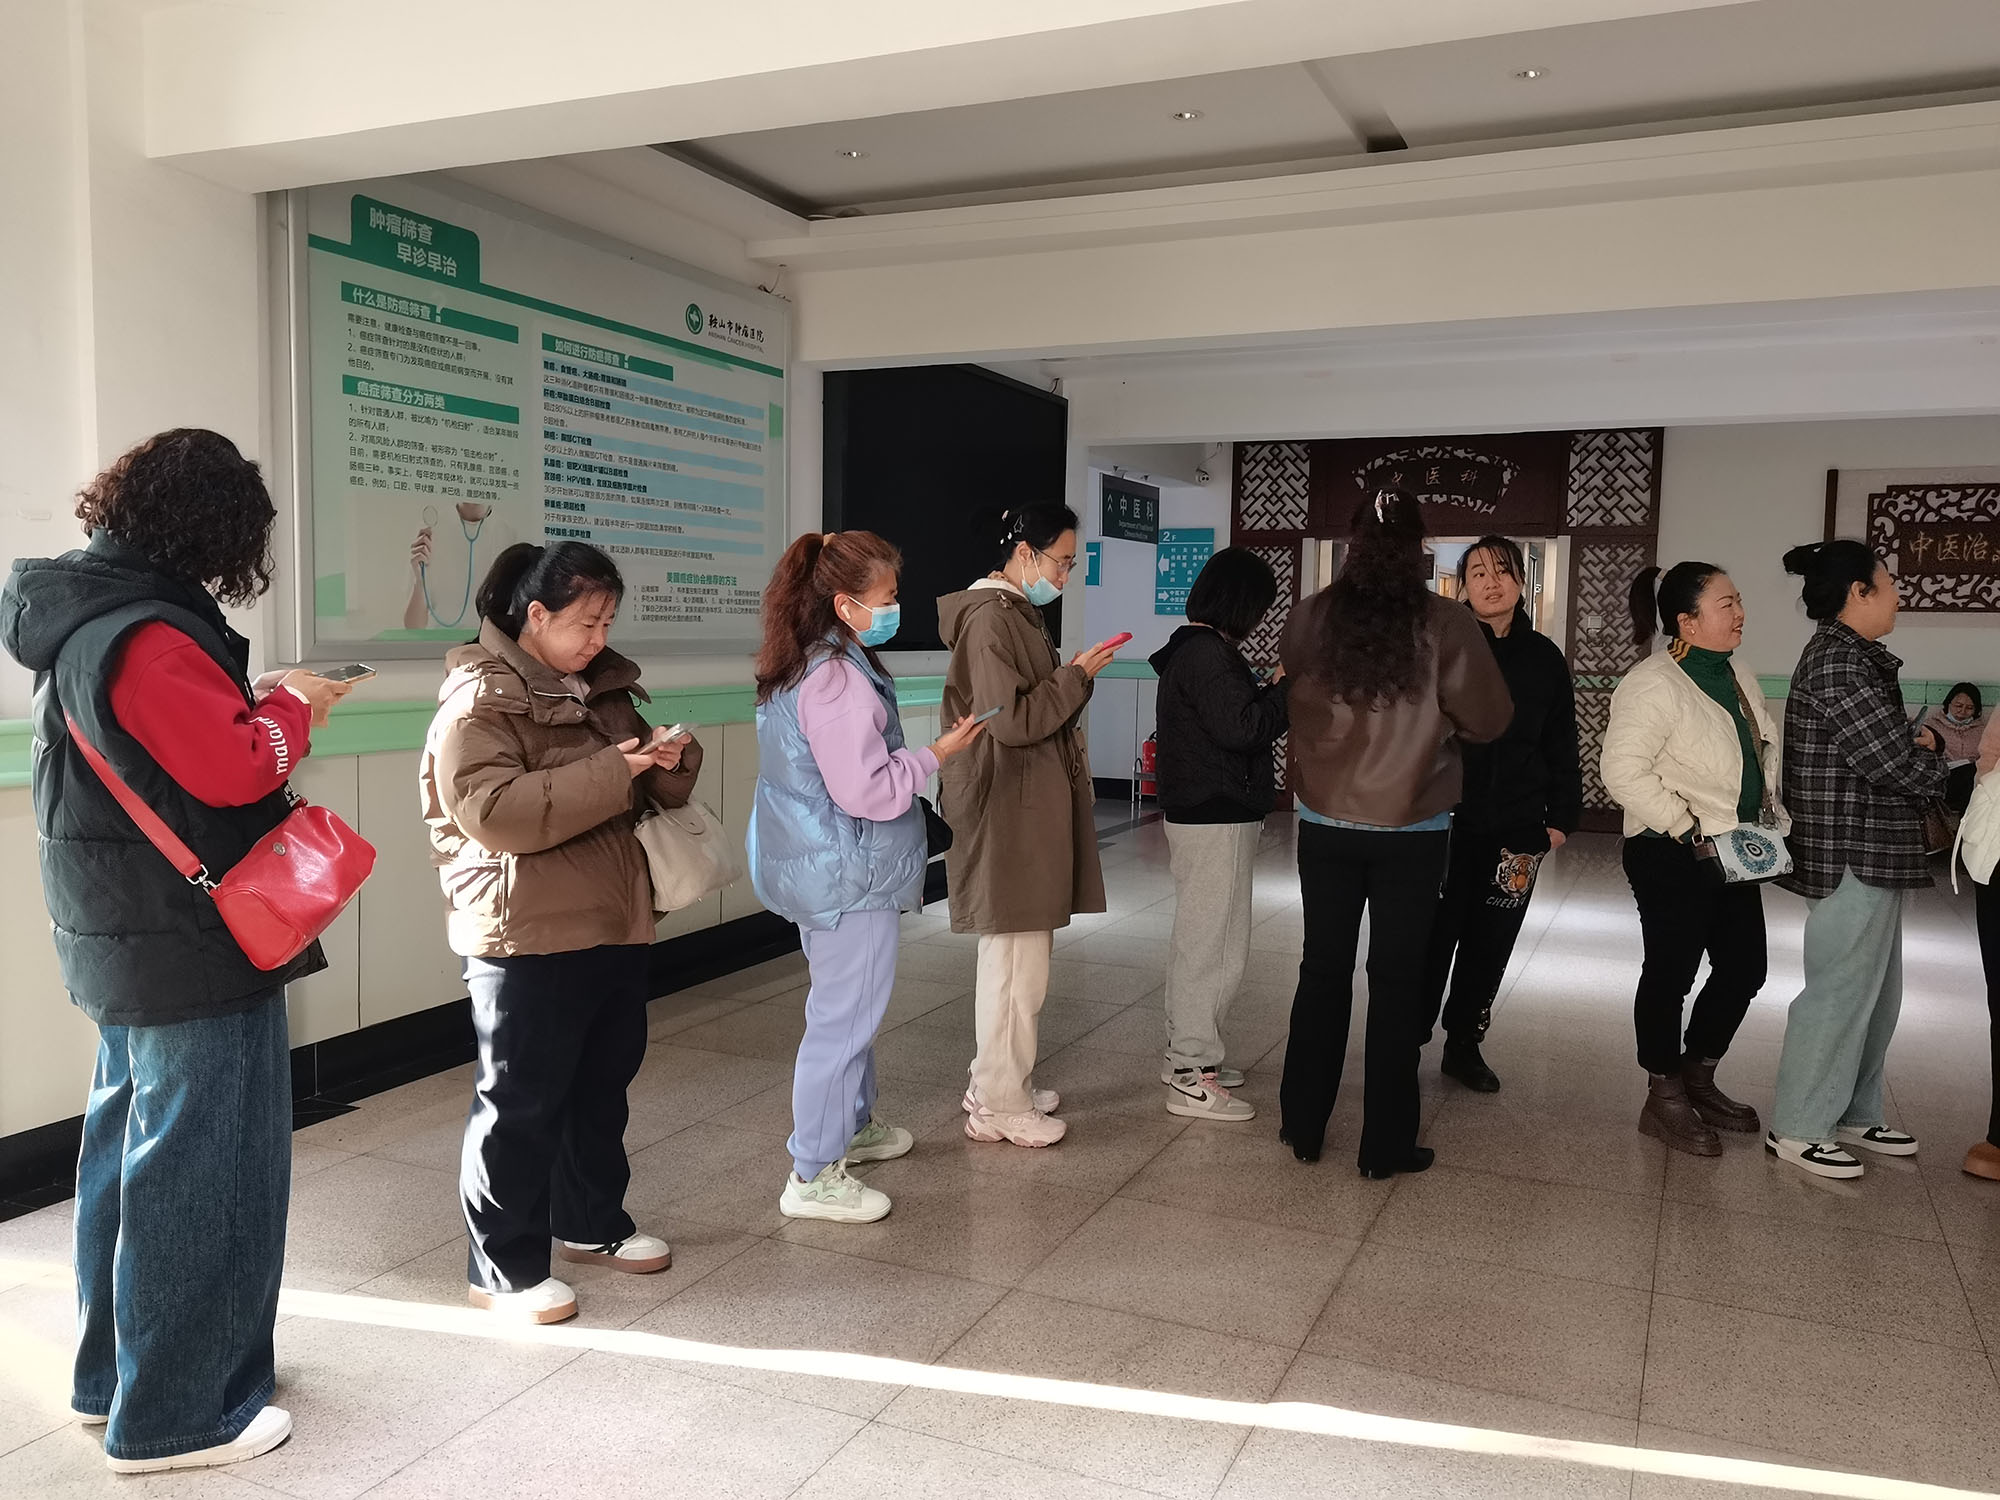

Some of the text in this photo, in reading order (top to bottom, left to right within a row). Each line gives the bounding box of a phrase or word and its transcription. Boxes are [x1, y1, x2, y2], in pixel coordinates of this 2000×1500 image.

[369, 207, 433, 246] 肿瘤筛查
[396, 243, 458, 278] 早诊早治
[357, 381, 446, 410] 癌症筛查分为两类
[1119, 495, 1154, 522] 中医科
